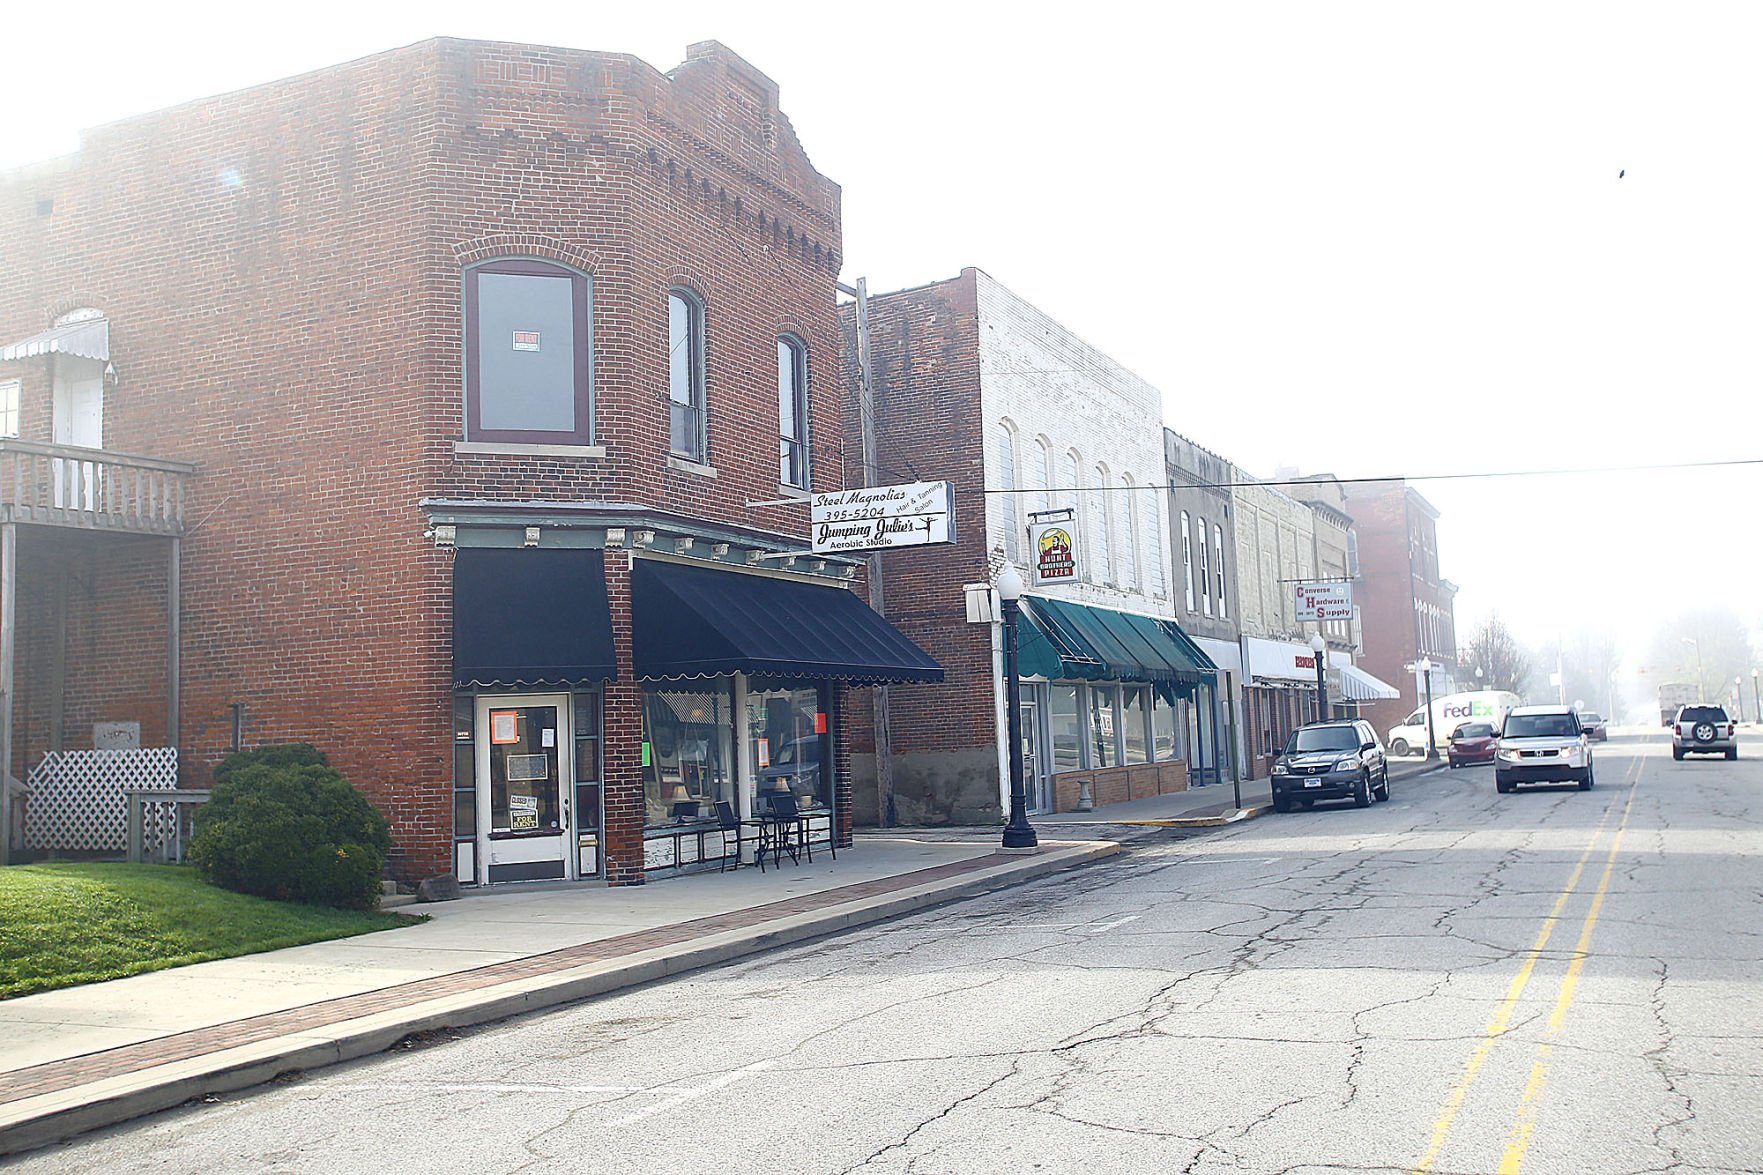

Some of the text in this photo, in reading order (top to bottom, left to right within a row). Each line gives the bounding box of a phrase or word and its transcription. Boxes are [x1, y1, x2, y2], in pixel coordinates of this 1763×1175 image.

[813, 488, 905, 507] Steel Magnolias
[896, 502, 909, 513] Hair
[917, 482, 943, 499] Tanning
[914, 499, 933, 513] Salon
[824, 507, 884, 520] 395-5204
[817, 518, 914, 544] Jumping Julie's
[830, 537, 892, 549] Aerobic Studio
[1045, 554, 1066, 563] HUNT
[1044, 568, 1070, 577] PIZZA
[1297, 587, 1331, 597] Converse
[1306, 597, 1344, 608] Hardware
[1317, 607, 1350, 618] Supply
[1444, 700, 1493, 718] FedEx
